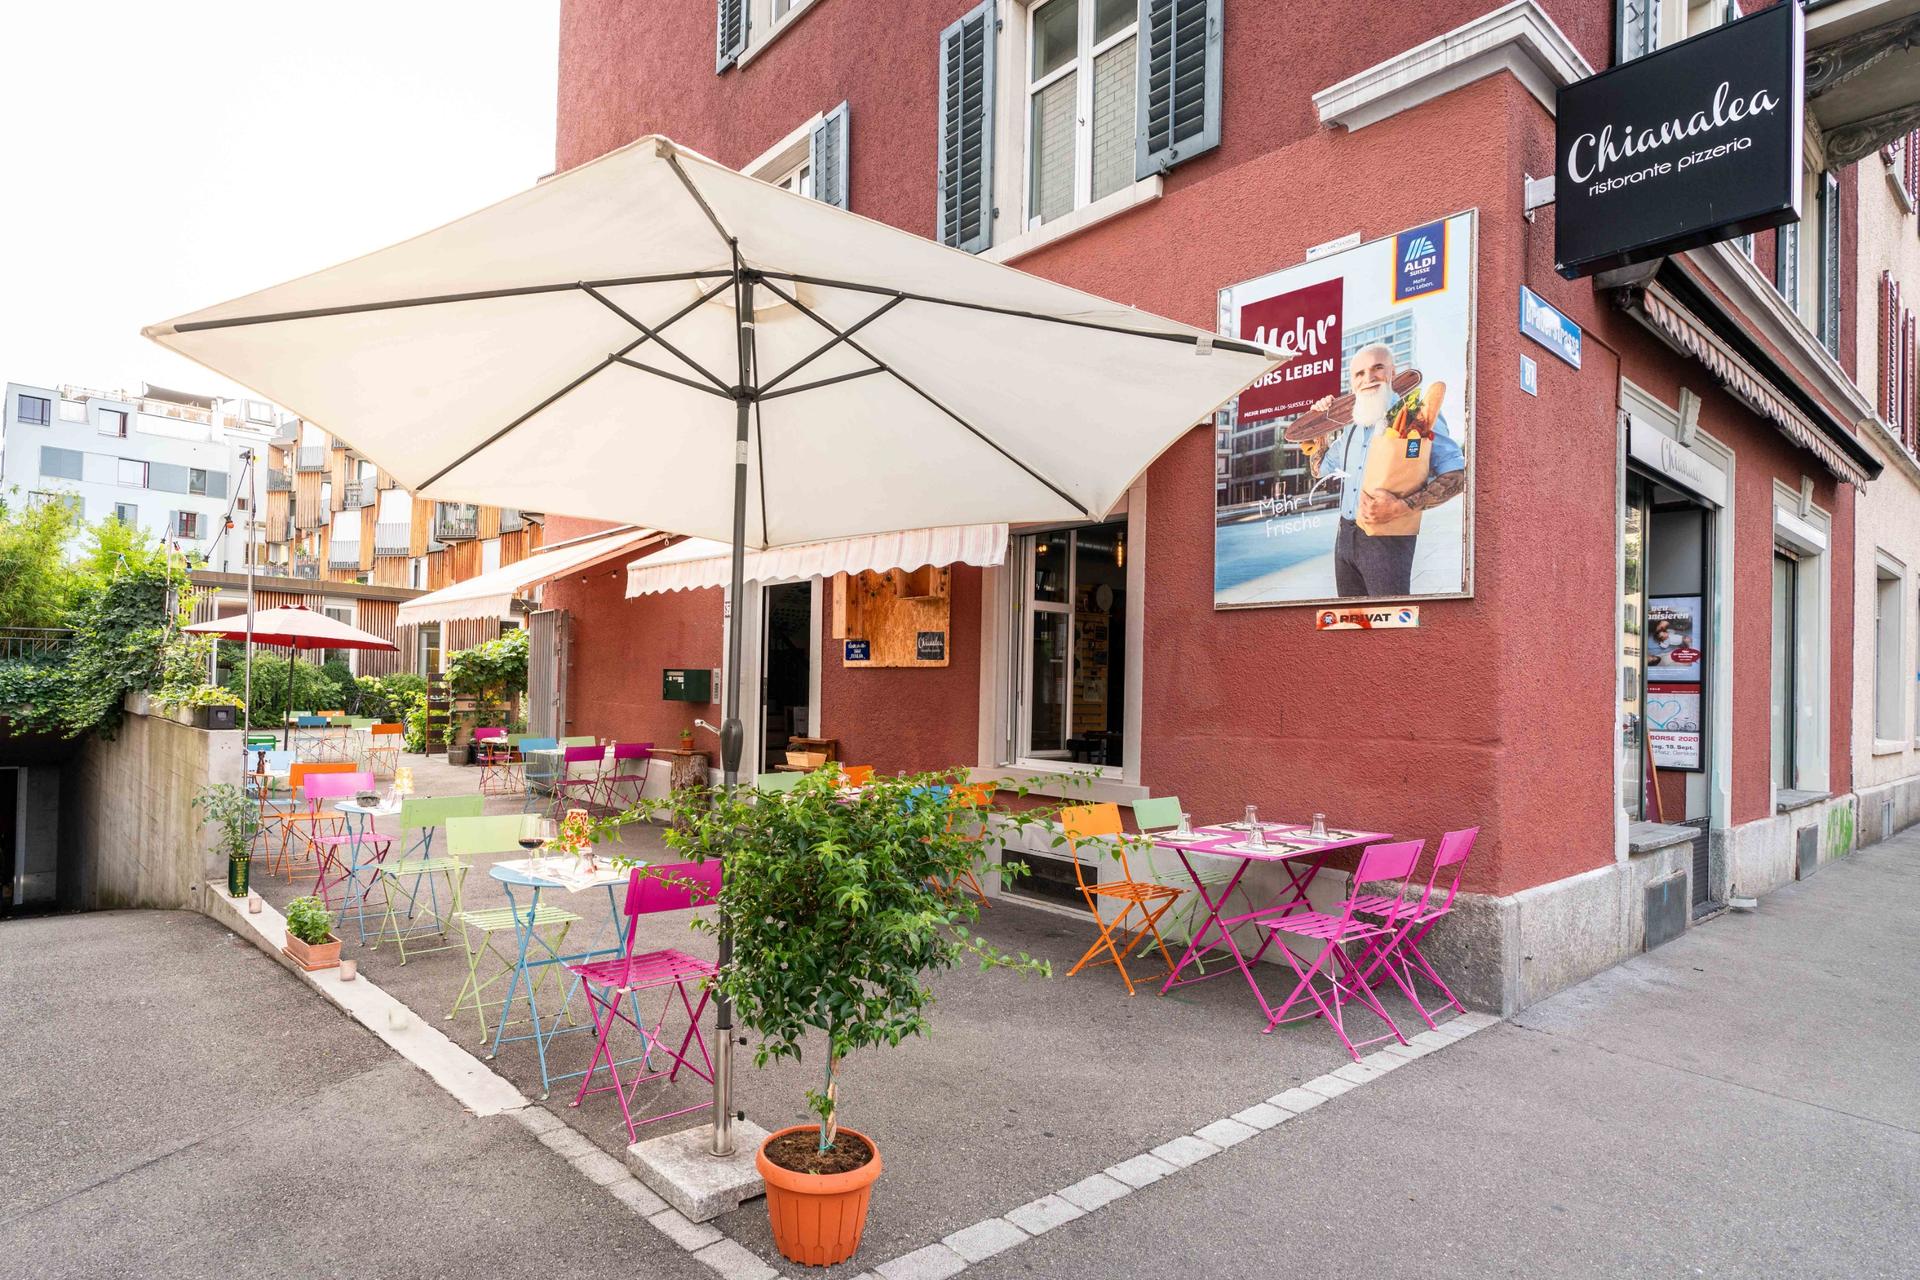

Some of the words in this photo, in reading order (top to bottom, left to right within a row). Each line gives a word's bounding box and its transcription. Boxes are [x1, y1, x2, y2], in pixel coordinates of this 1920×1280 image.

[1567, 81, 1780, 184] Chianalea
[1588, 162, 1672, 197] ristorante
[1677, 137, 1752, 172] pizzeria
[1404, 255, 1436, 273] ALDI
[1409, 267, 1431, 277] SUISSE
[1253, 314, 1336, 356] Mehr
[1285, 358, 1334, 382] LEBEN
[1259, 494, 1302, 518] Mehr
[1265, 512, 1321, 538] Frische
[1339, 613, 1392, 623] PRIVAT
